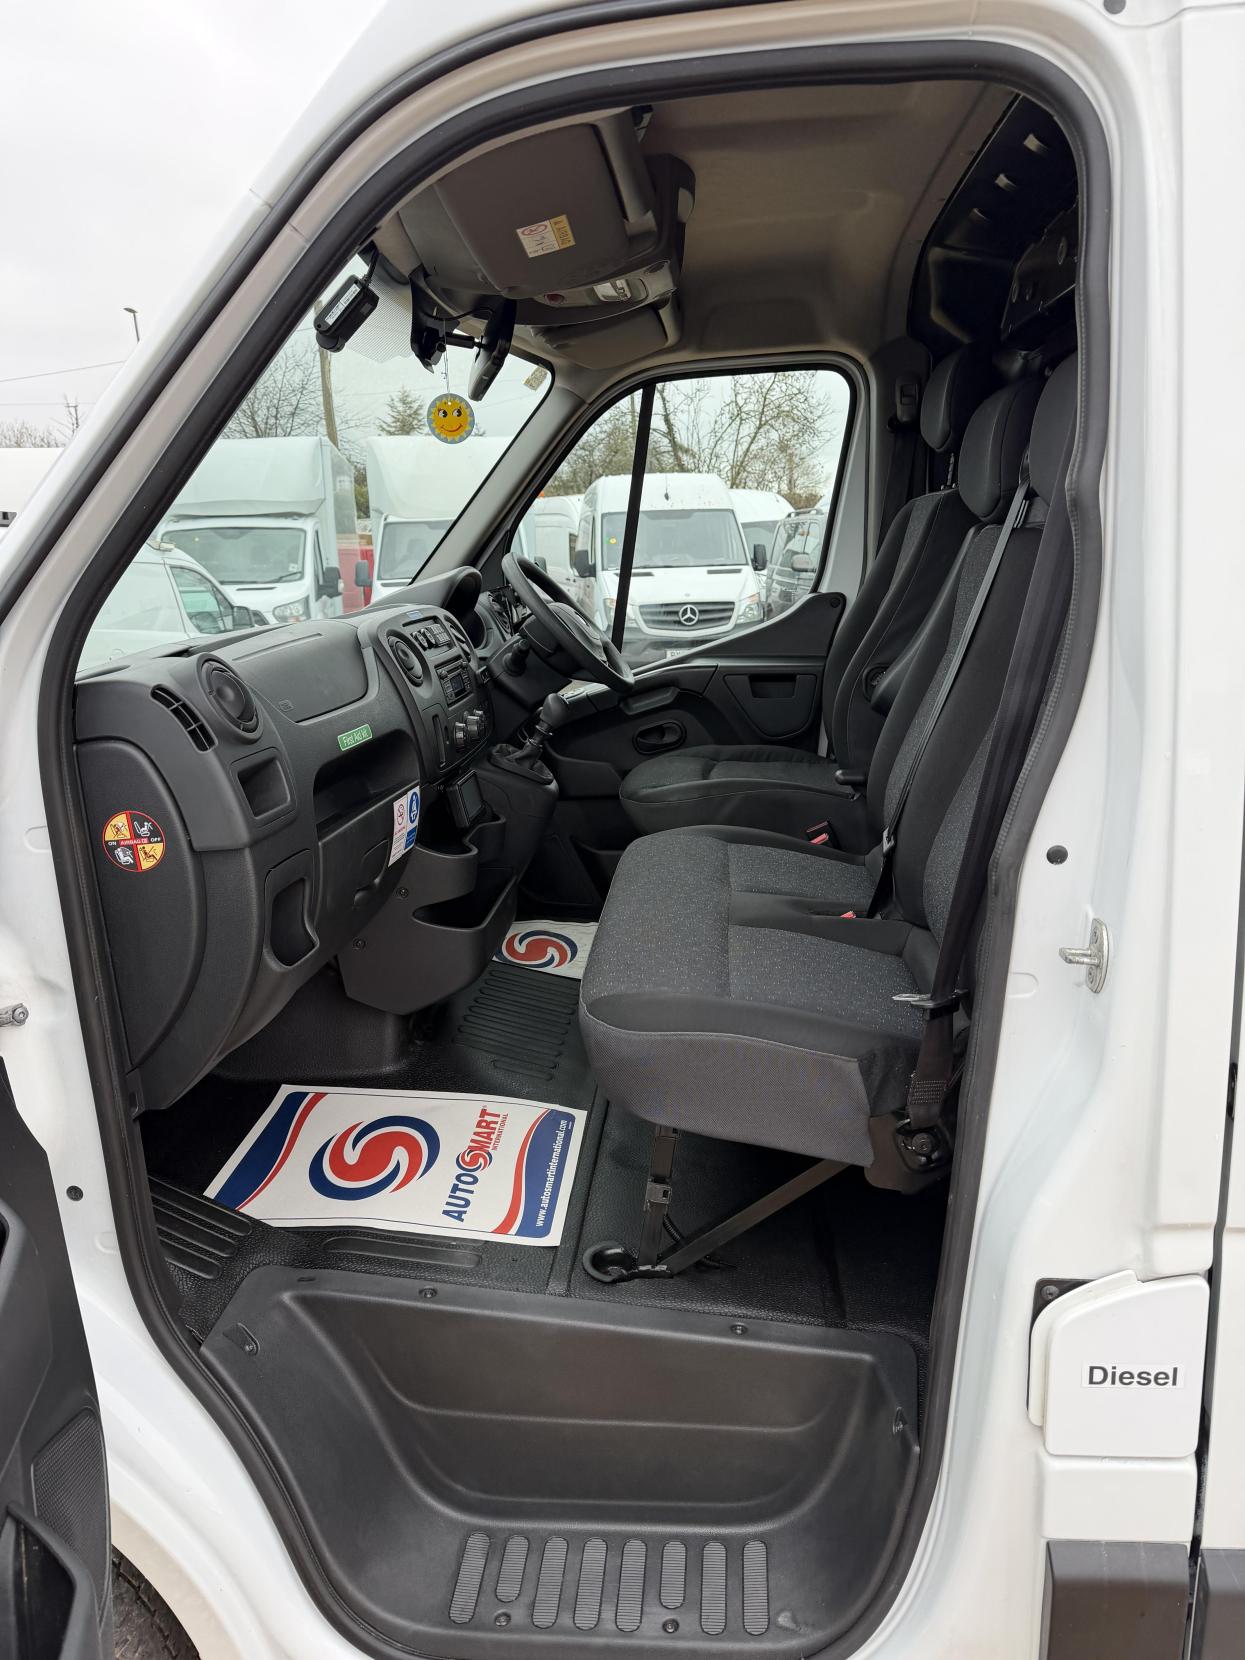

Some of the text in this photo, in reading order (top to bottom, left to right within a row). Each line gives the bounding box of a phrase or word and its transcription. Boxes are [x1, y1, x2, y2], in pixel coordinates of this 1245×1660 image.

[491, 1113, 508, 1151] INTERNATIONAL
[536, 1119, 568, 1226] www.autosmartinternational.com
[1088, 1365, 1178, 1386] Diesel
